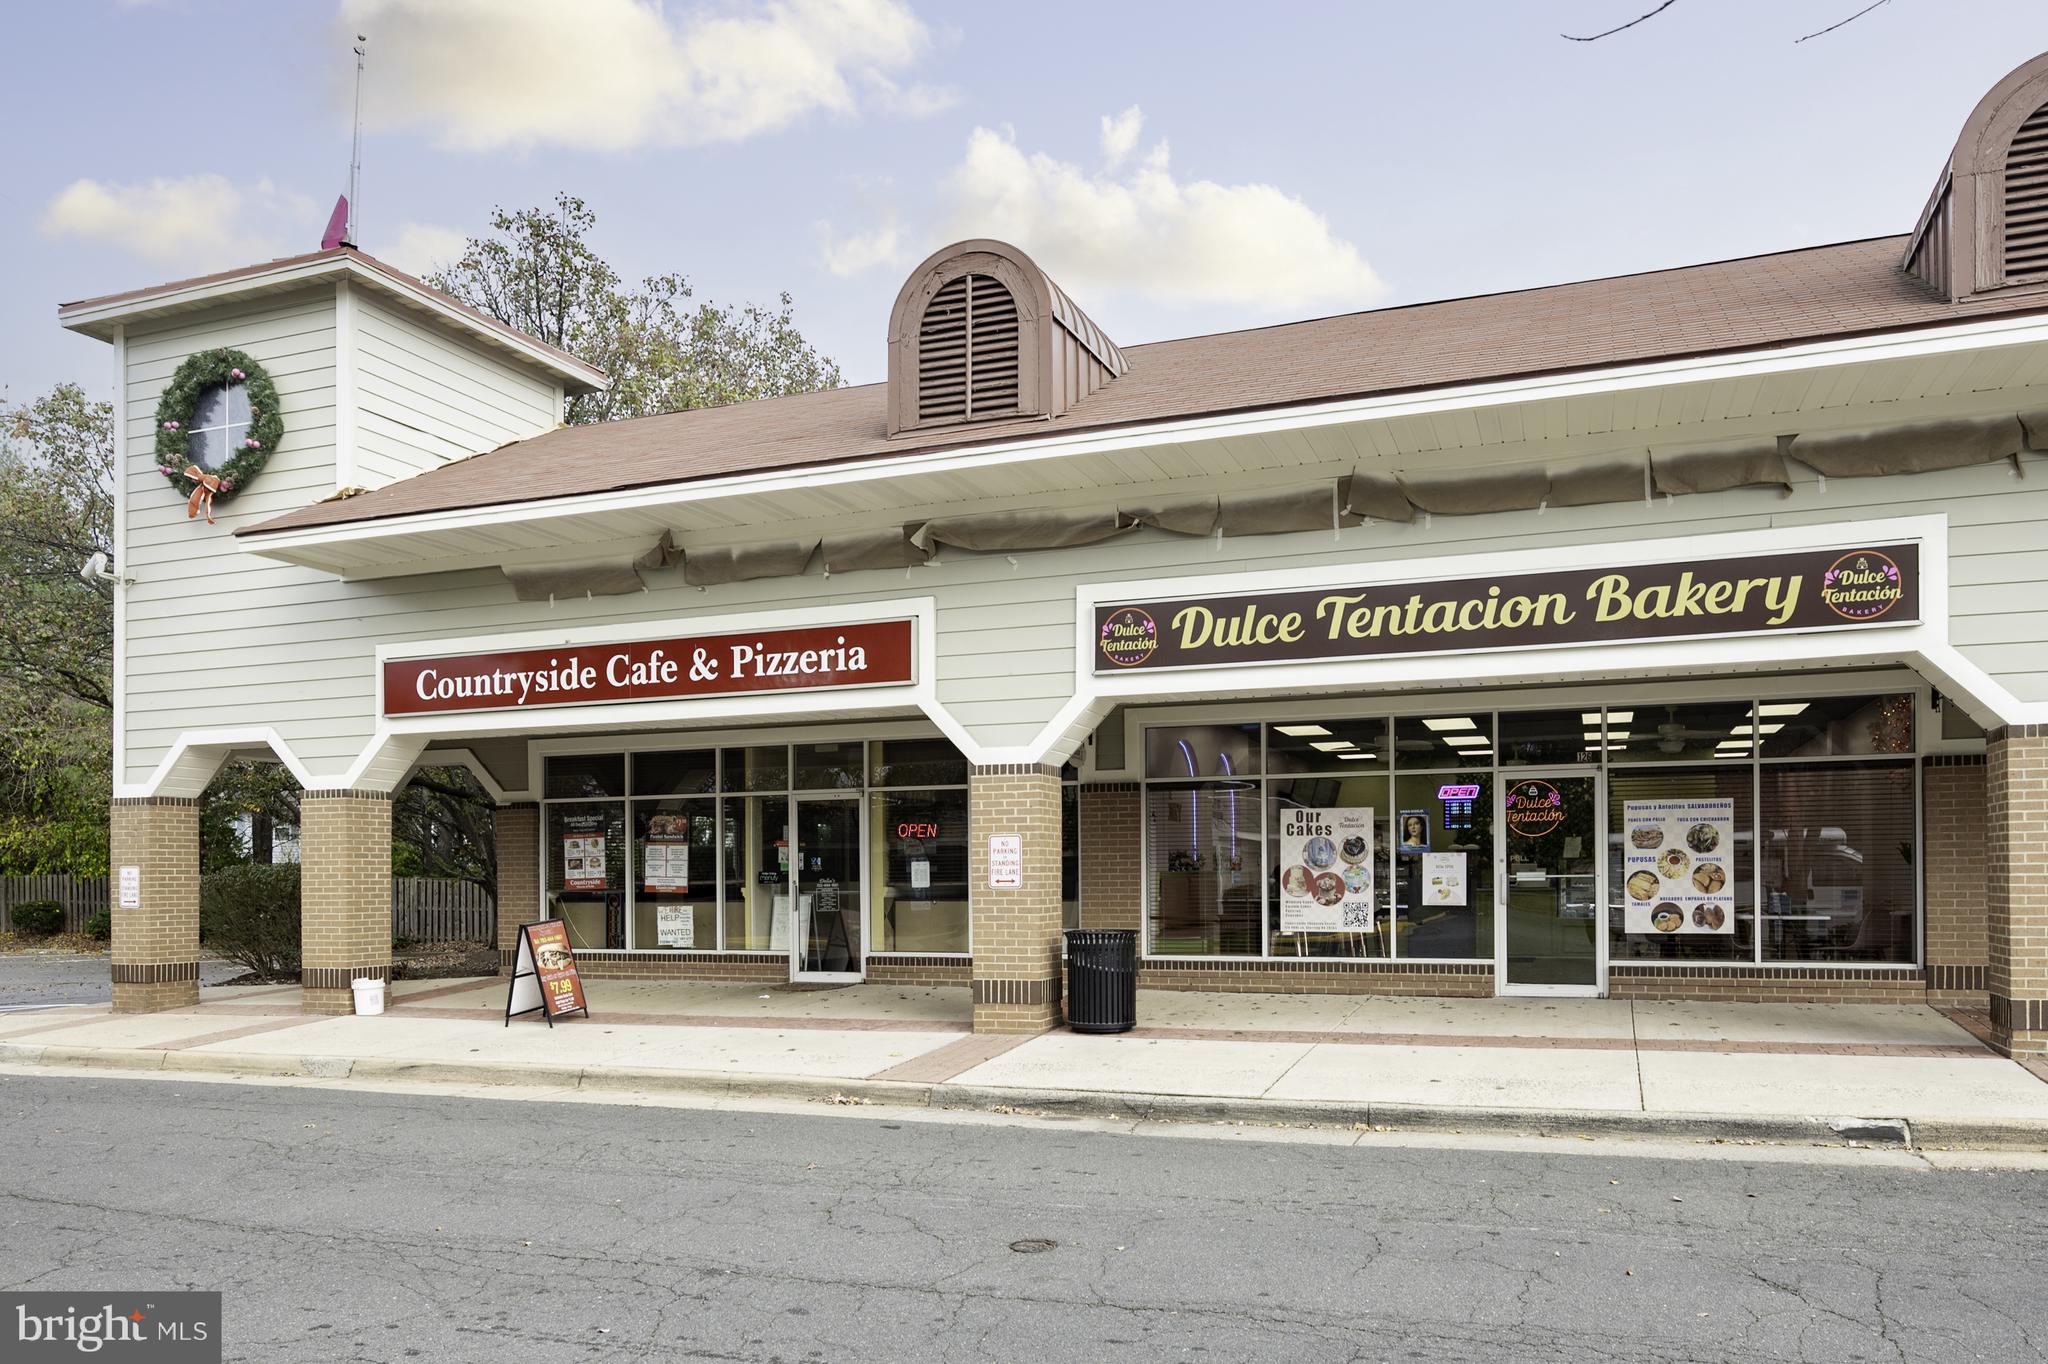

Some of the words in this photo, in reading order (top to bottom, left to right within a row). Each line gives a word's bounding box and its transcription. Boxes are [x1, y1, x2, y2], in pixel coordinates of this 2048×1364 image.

[1838, 570, 1886, 586] Dulce
[1821, 586, 1904, 604] Tentación
[1171, 604, 1306, 650] Dulce
[1316, 585, 1576, 640] Tentacion
[1586, 572, 1803, 626] Bakery
[1842, 604, 1884, 615] BAKERY
[1112, 624, 1146, 637] Dulce
[1100, 638, 1159, 652] Tentación
[416, 658, 596, 704] Countryside
[606, 650, 678, 687] Cafe
[690, 648, 718, 681] &
[730, 636, 868, 678] Pizzeria
[1577, 752, 1593, 762] 126
[1440, 788, 1476, 797] OPEN
[1516, 796, 1552, 808] Dulce
[1296, 810, 1321, 823] Our
[898, 824, 937, 838] OPEN
[1286, 823, 1332, 836] Cakes
[549, 979, 572, 994] $7.99
